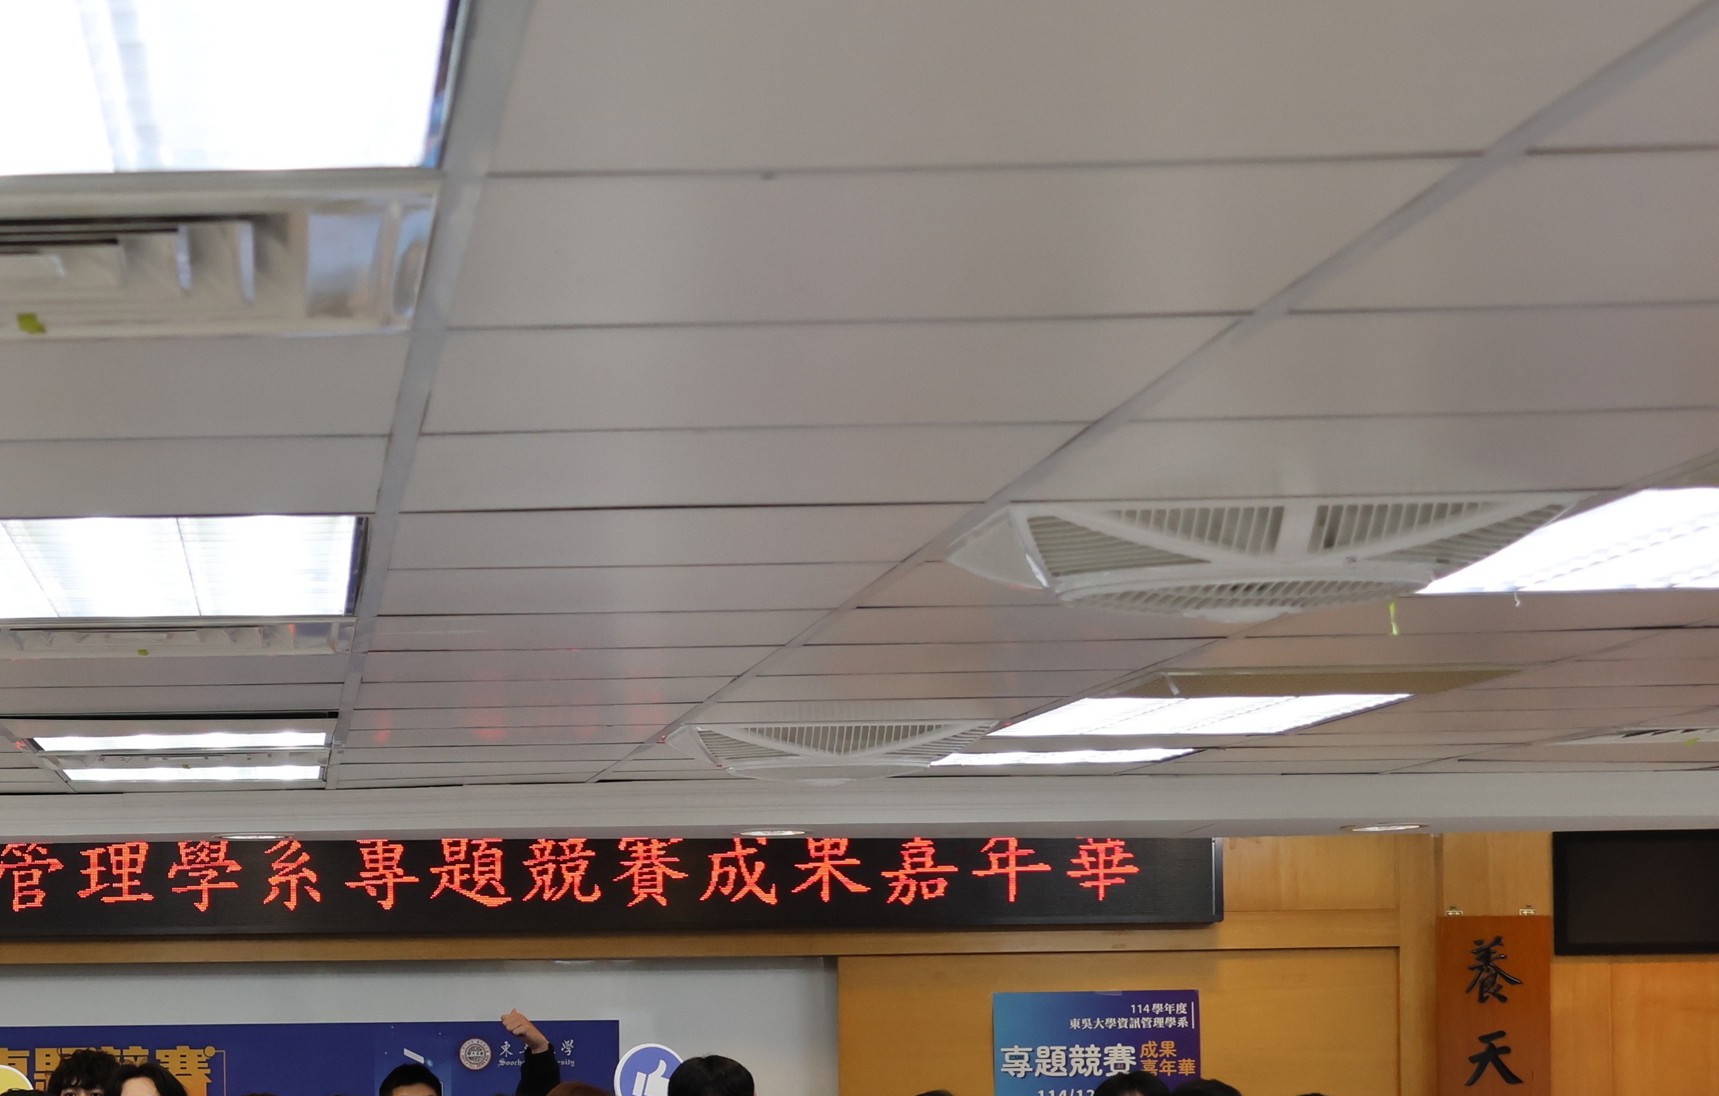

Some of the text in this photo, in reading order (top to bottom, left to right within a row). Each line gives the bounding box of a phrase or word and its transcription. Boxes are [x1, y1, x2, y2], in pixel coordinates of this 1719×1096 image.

[1130, 1003, 1188, 1016] 114學年度
[1070, 1017, 1189, 1030] 東吳大學資訊管理學系
[1140, 1041, 1177, 1059] 成果
[1000, 1043, 1137, 1078] 專題競賽
